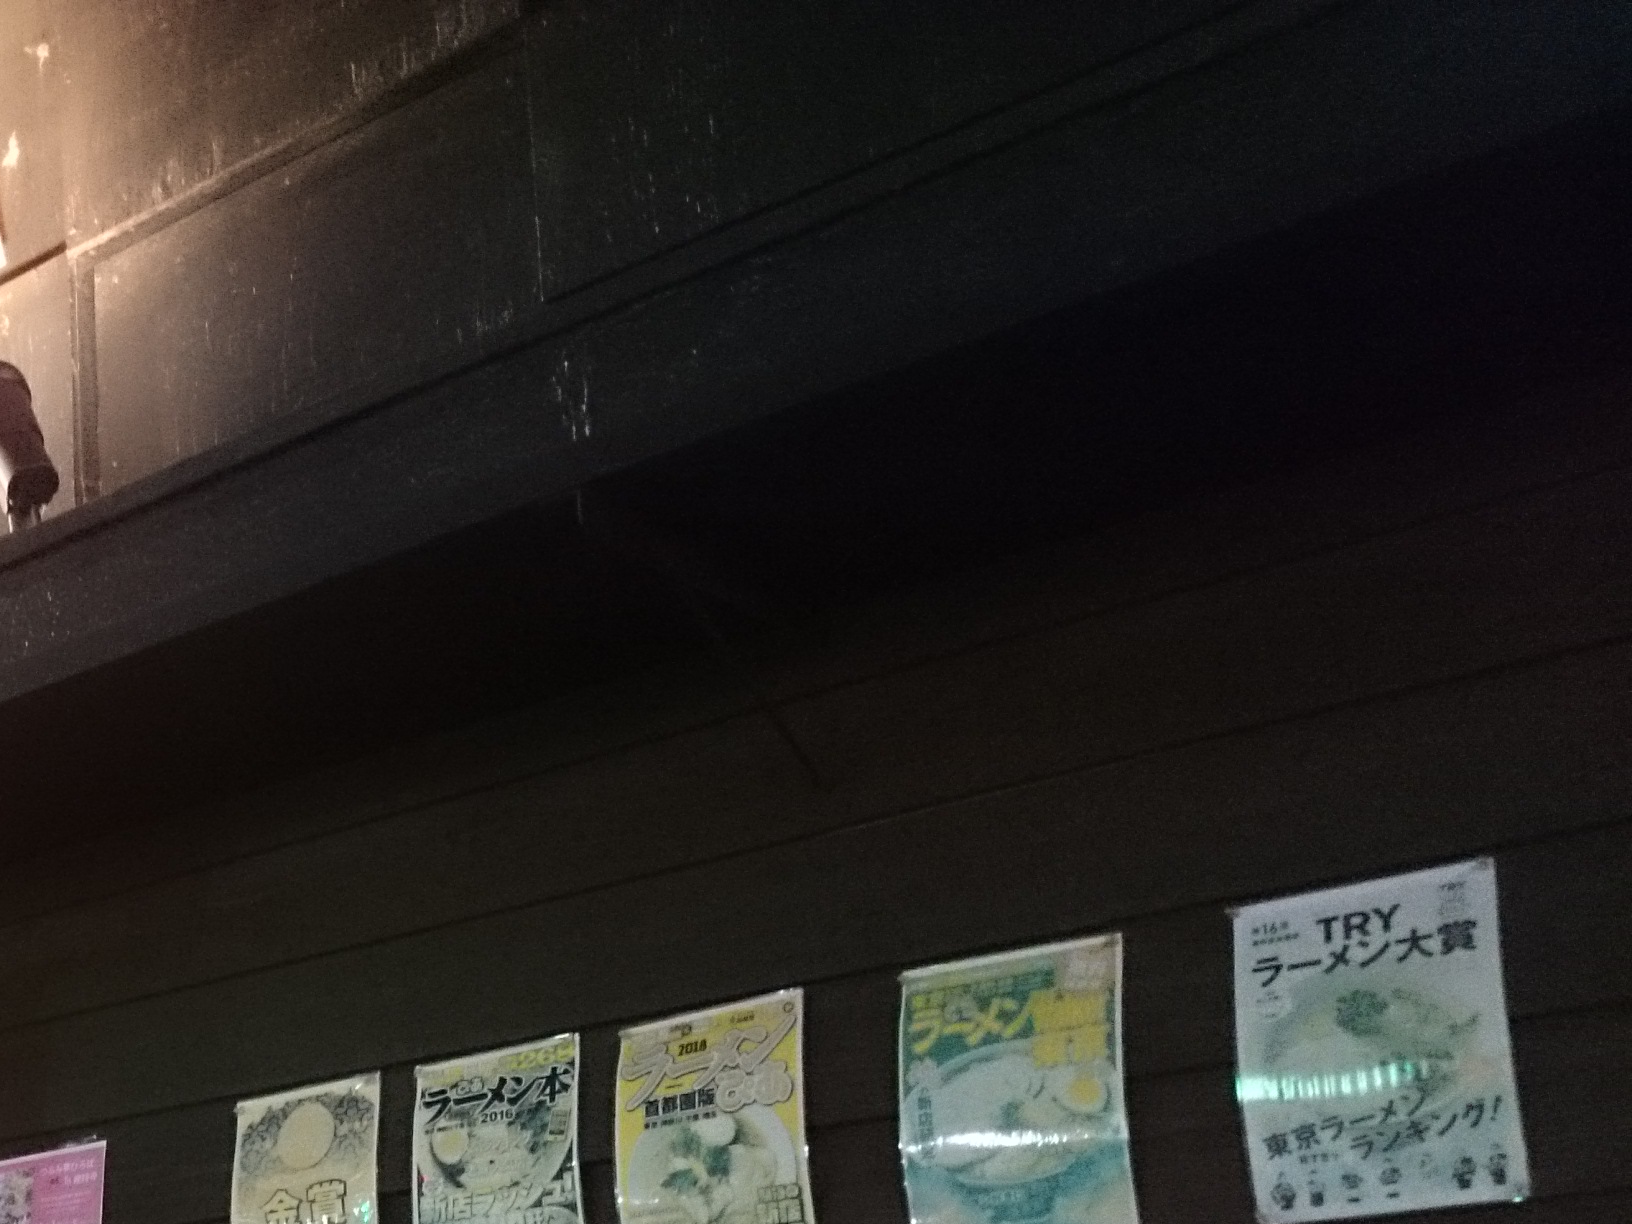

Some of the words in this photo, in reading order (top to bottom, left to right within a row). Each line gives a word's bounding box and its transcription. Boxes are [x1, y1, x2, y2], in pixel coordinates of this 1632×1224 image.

[1251, 919, 1478, 989] ラーメン大賞
[1315, 903, 1402, 944] TRY
[622, 1014, 797, 1111] ラーメン
[422, 1065, 573, 1127] ラーメン本
[480, 1110, 514, 1124] 2016
[1262, 1085, 1430, 1161] 東京ラーメン
[1350, 1094, 1504, 1160] ランキング!
